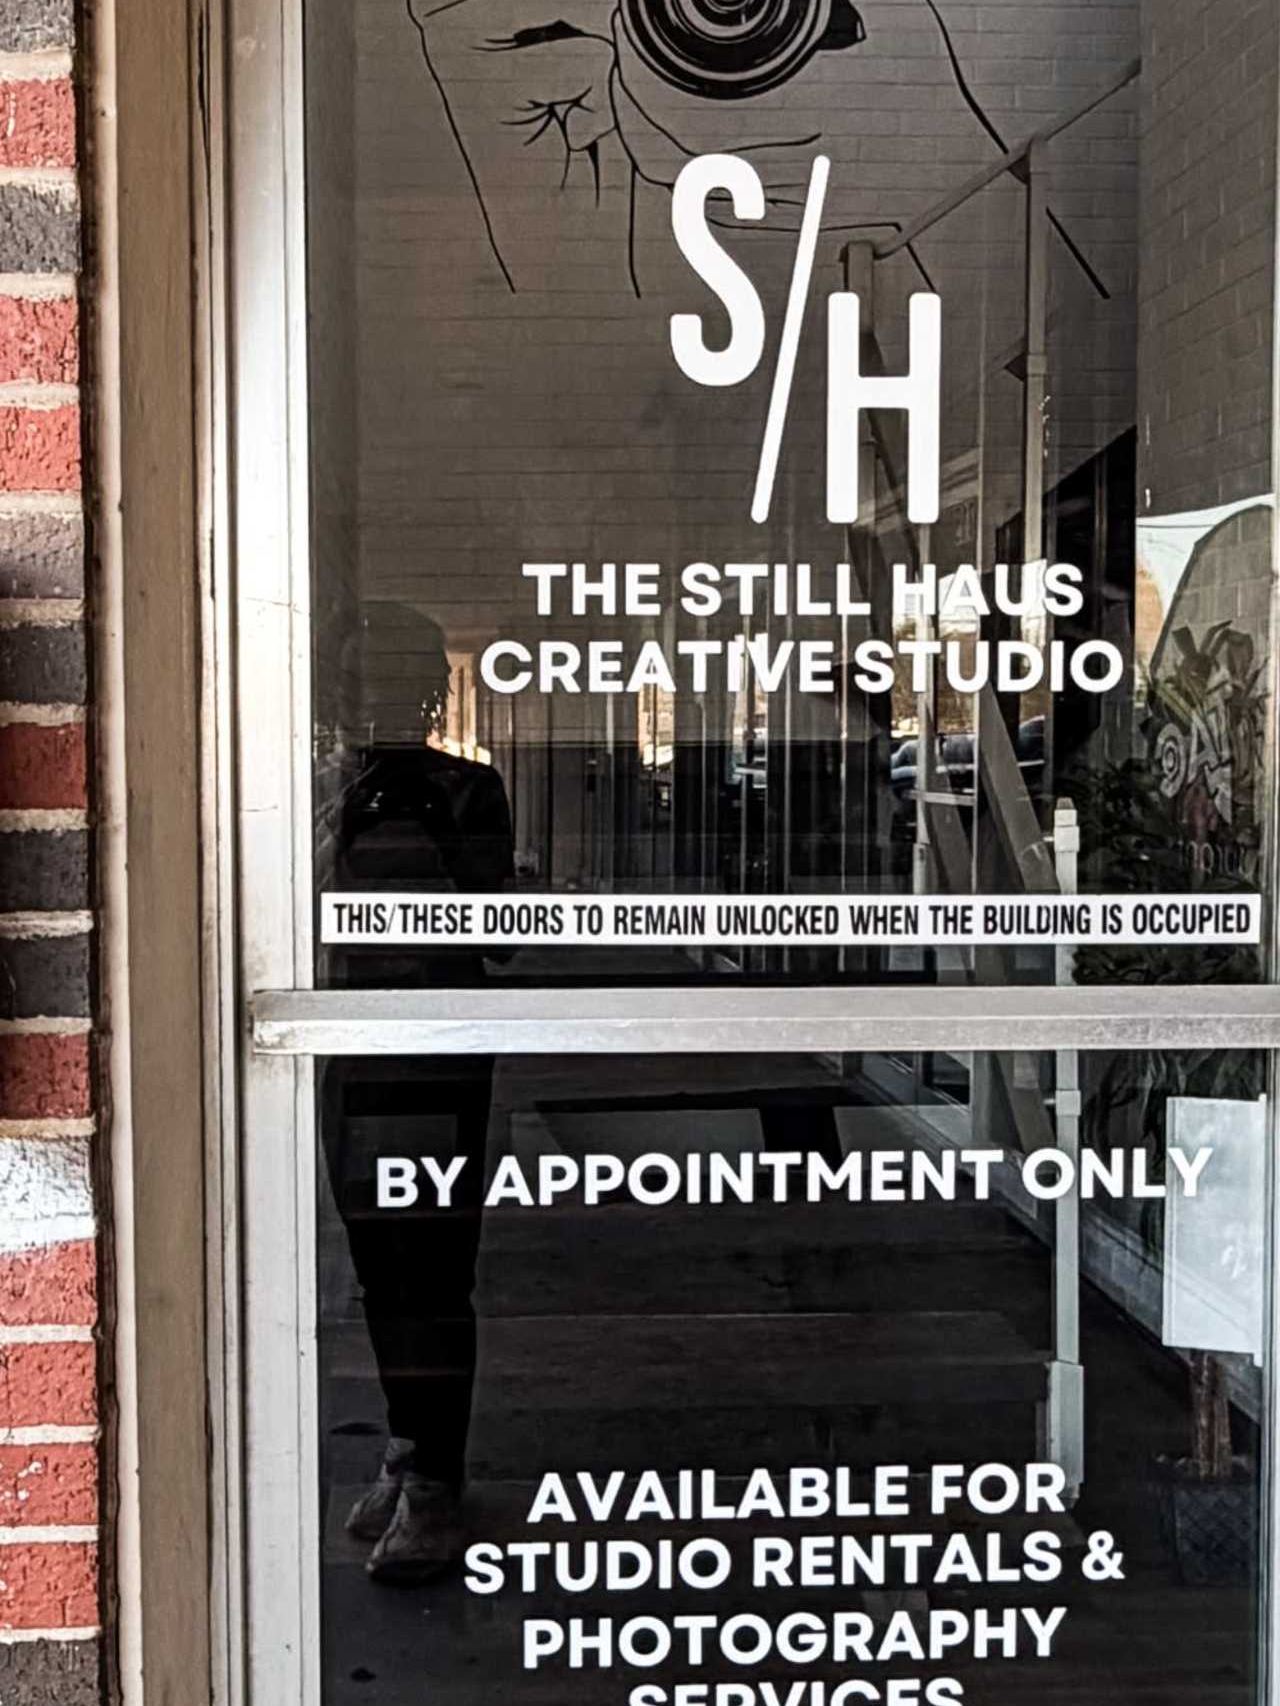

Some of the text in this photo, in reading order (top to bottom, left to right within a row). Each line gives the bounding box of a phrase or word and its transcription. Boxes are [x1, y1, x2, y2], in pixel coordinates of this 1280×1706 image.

[670, 153, 941, 524] S/H
[523, 563, 1084, 618] THE STILL HAUS
[481, 639, 1124, 694] CREATIVE STUDIO
[333, 903, 1251, 936] THIS/THESE DOORS TO REMAIN UNLOCKED WHEN THE BUILDING IS OCCUPIED
[376, 1146, 1214, 1208] BY APPOINTMENT ONLY
[527, 1462, 1066, 1523] AVAILABLE FOR
[464, 1530, 1125, 1594] STUDIO RENTALS &
[523, 1607, 1067, 1669] PHOTOGRAPHY
